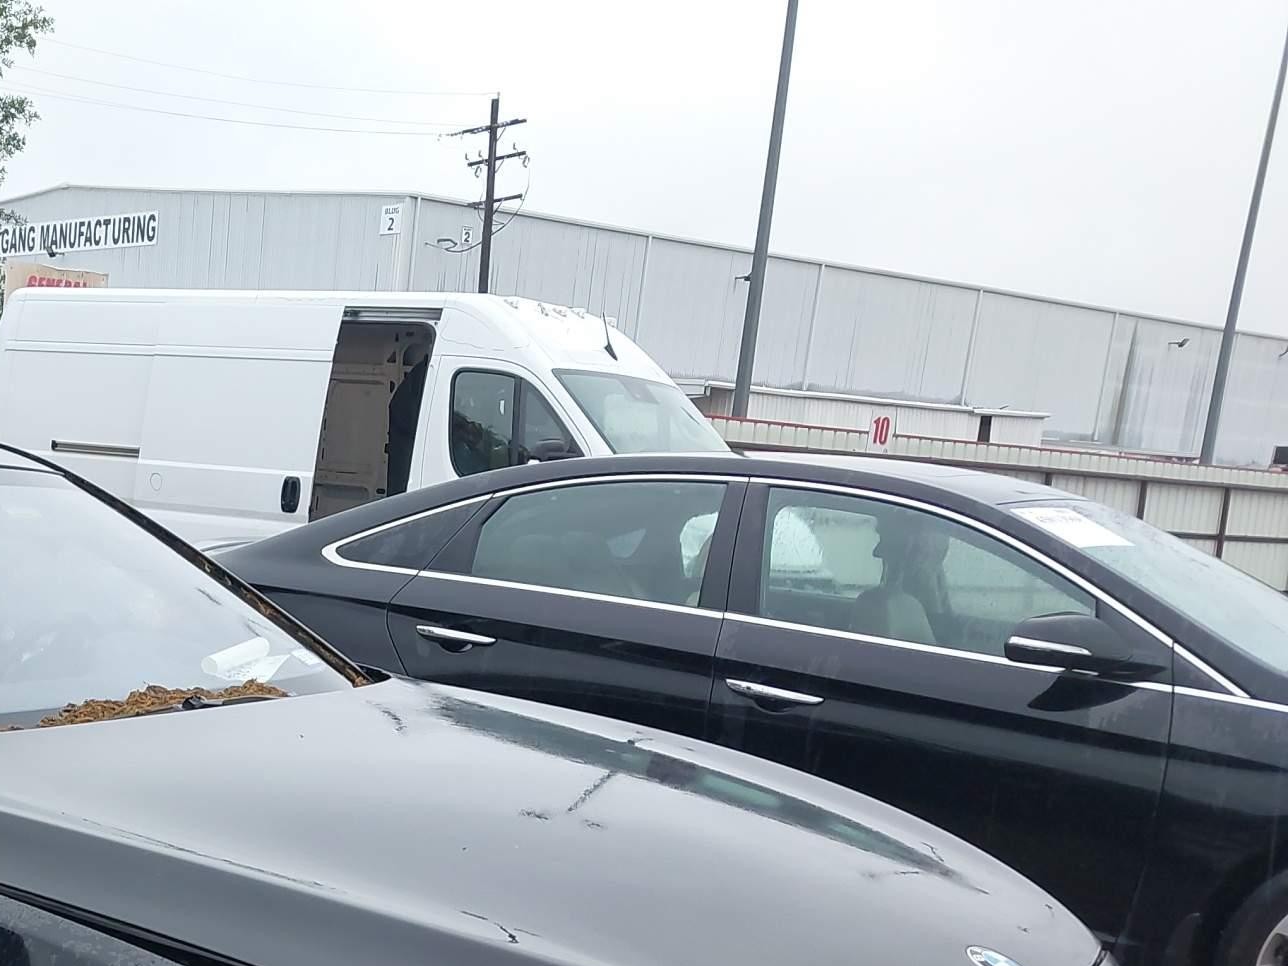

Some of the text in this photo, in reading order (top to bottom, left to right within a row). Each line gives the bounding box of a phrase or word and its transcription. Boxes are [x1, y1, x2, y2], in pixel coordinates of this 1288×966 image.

[1, 225, 36, 254] GANG
[39, 213, 157, 251] MANUFACTURING
[387, 217, 394, 231] 2
[464, 231, 470, 243] 2
[873, 416, 890, 445] 10
